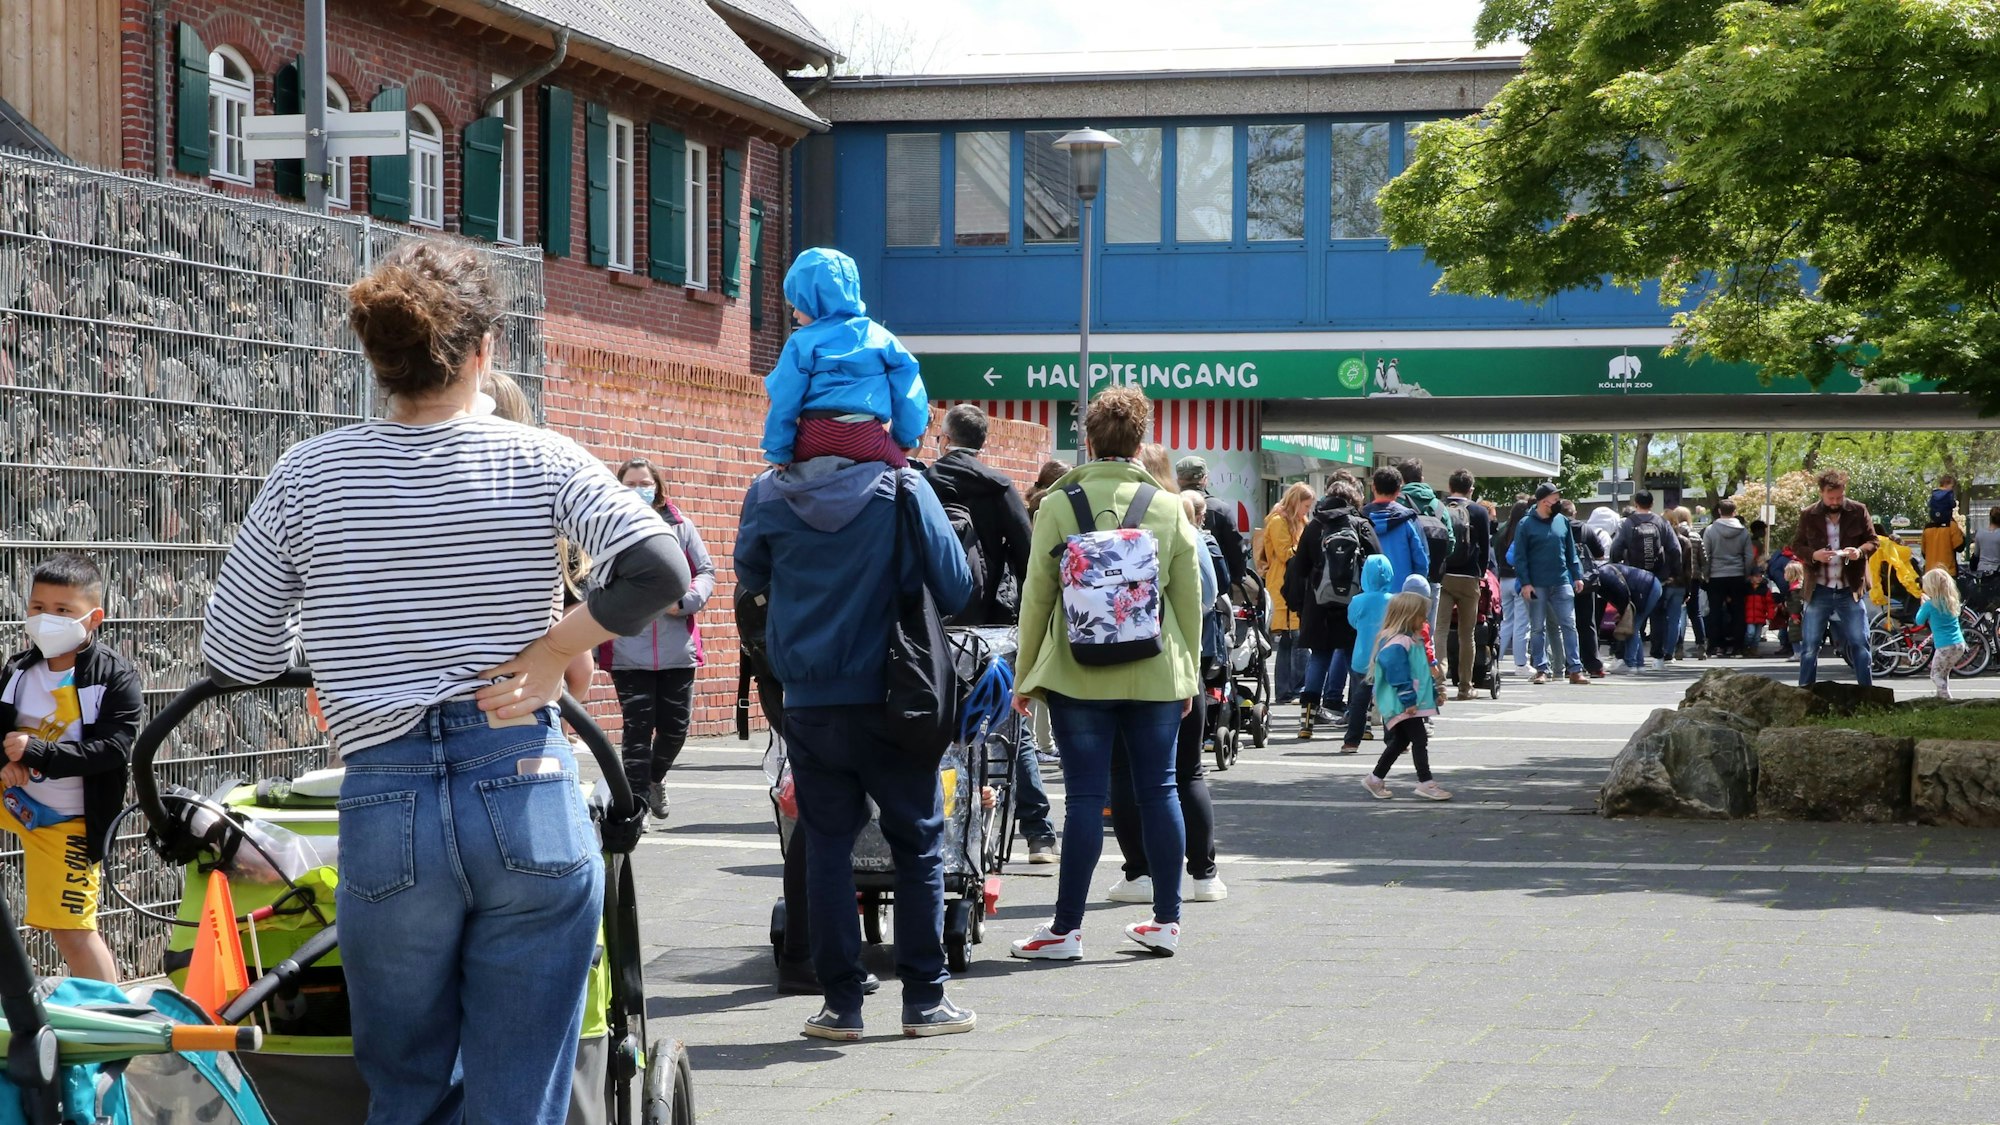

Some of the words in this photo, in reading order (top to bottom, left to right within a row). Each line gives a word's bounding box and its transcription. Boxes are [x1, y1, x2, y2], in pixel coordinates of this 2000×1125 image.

[1027, 361, 1259, 389] HAUPTEINGANG
[1598, 381, 1633, 389] KÖLNER
[60, 889, 87, 915] UP
